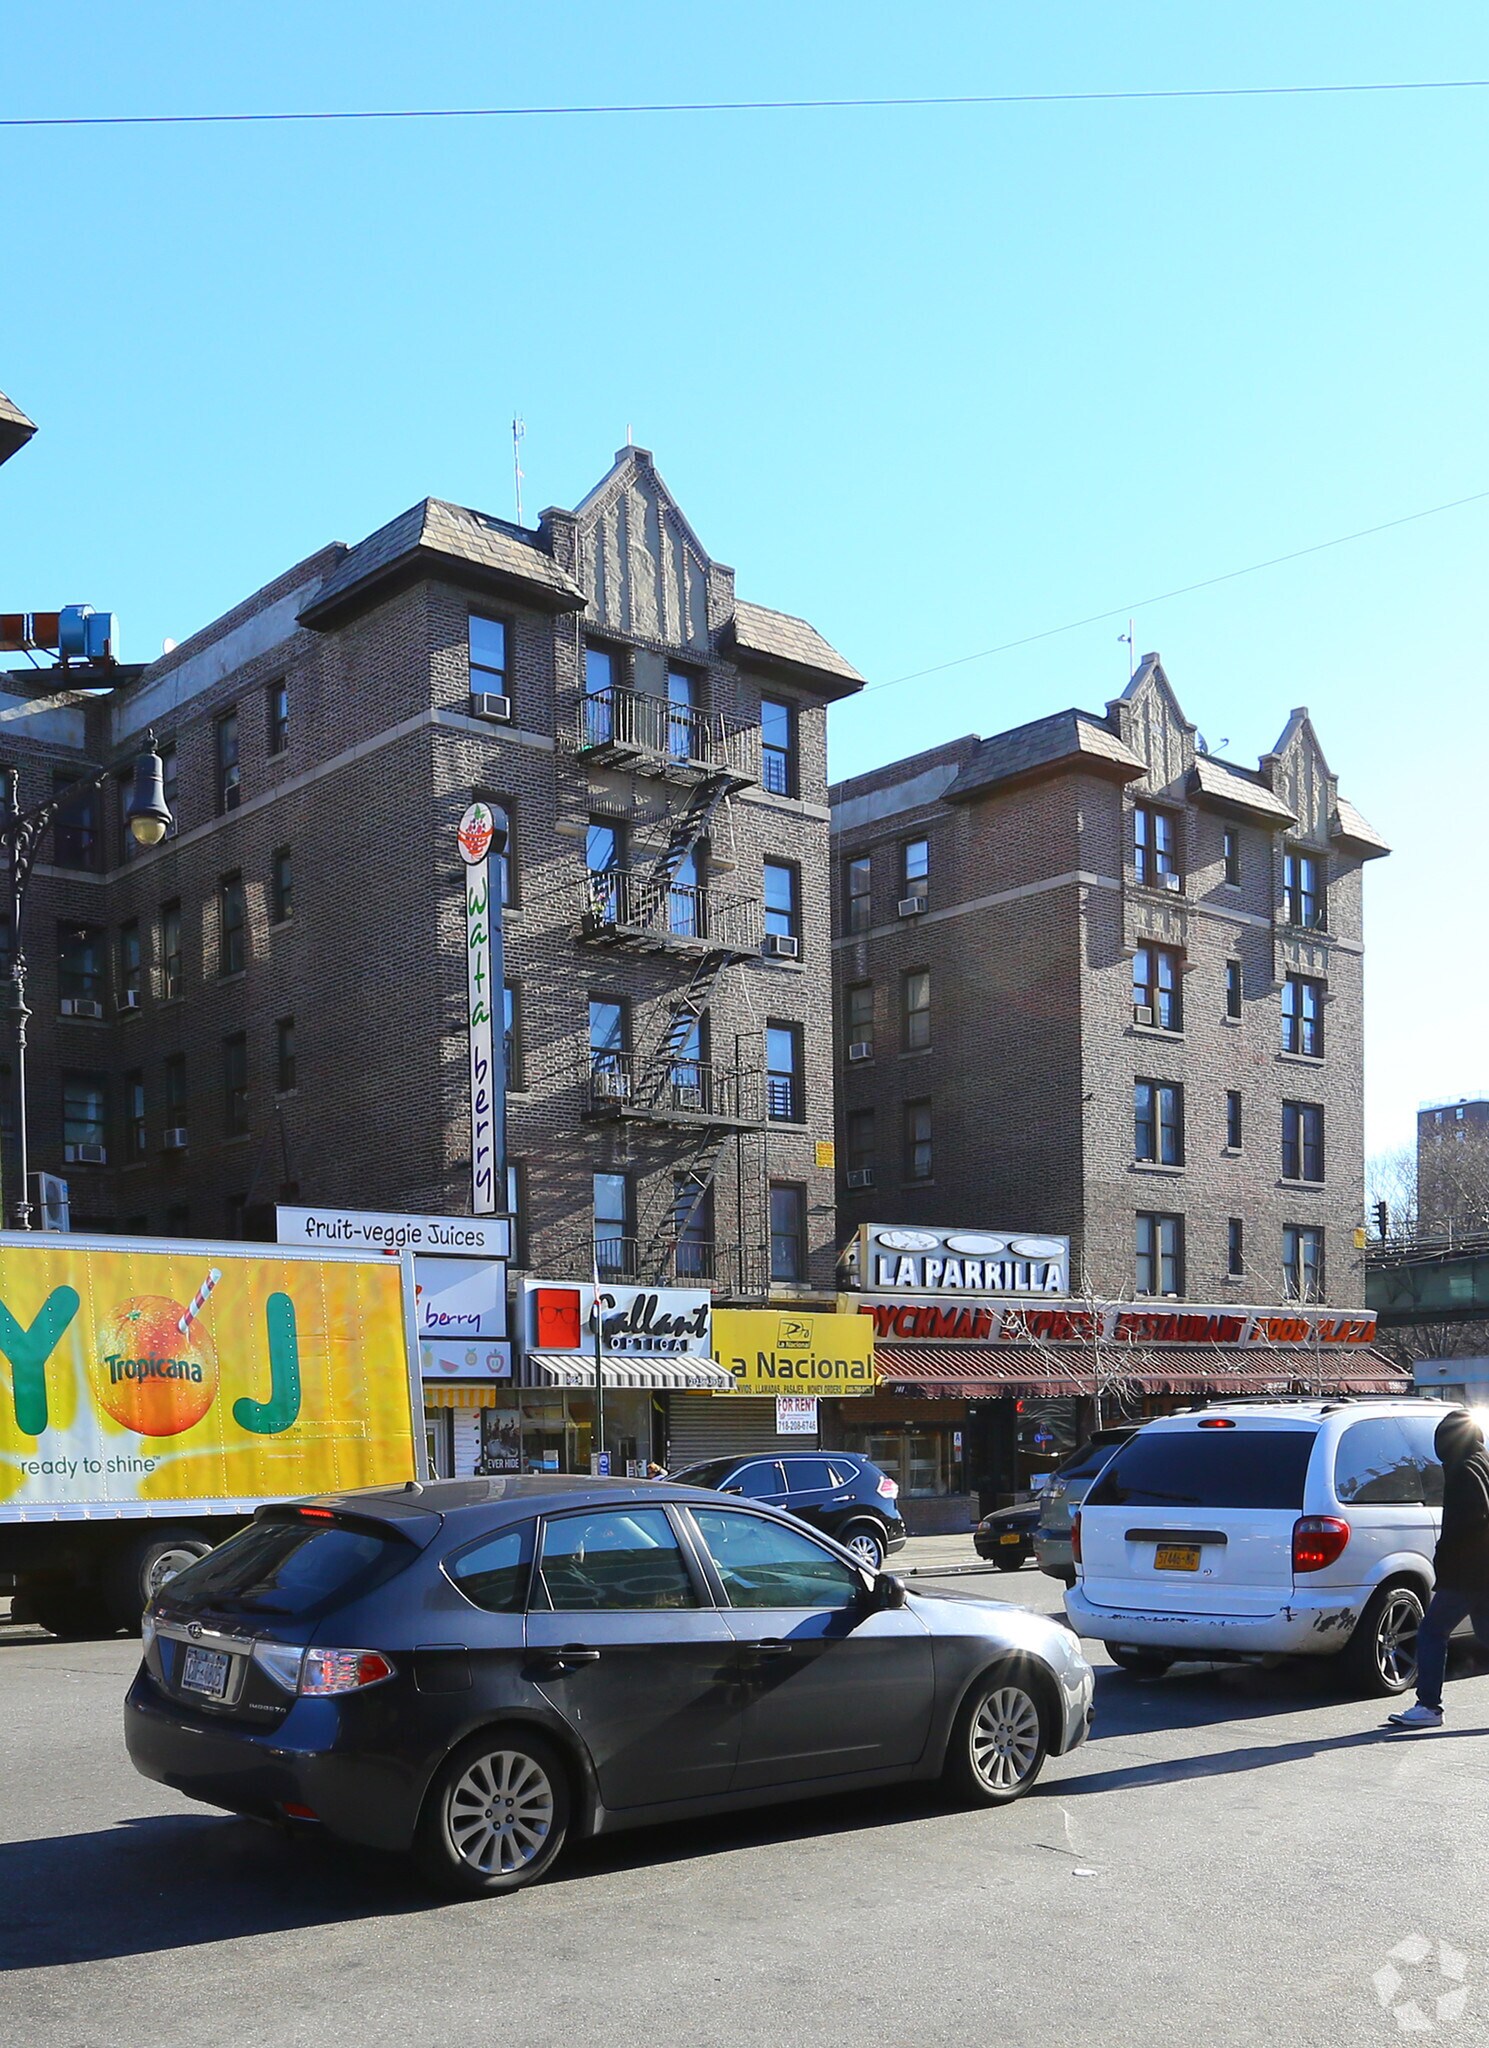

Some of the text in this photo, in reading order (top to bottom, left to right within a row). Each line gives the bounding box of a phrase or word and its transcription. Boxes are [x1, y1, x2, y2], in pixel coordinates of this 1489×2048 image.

[305, 1217, 485, 1246] fruit-veggie Juices
[877, 1254, 1063, 1292] LA PARRILLA
[425, 1302, 481, 1332] berry
[589, 1293, 709, 1347] Gallant
[1114, 1312, 1247, 1343] RESTAURANT
[610, 1337, 694, 1352] OPTICAL
[104, 1352, 202, 1384] Tropicana
[757, 1351, 873, 1379] Nacional
[778, 1398, 815, 1412] FOR RENT
[21, 1456, 78, 1479] ready
[83, 1457, 101, 1474] to
[505, 1458, 519, 1469] HIDE
